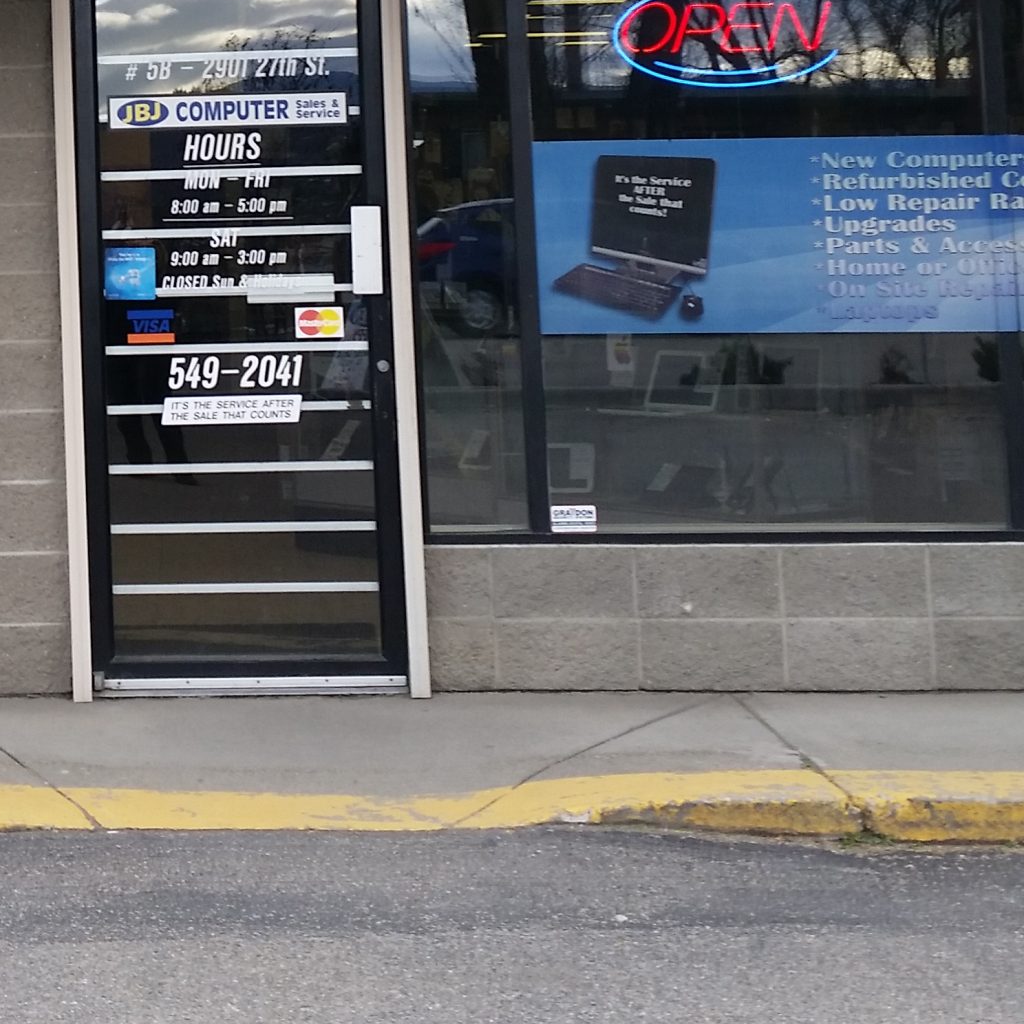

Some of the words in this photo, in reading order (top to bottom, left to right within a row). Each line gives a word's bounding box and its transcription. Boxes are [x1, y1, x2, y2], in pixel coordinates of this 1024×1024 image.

[620, 0, 832, 53] OPEN
[125, 65, 138, 80] #
[146, 61, 172, 80] 5B
[255, 57, 297, 77] 27th
[304, 56, 330, 76] St.
[123, 102, 161, 124] JBJ
[176, 100, 289, 122] COMPUTER
[296, 100, 326, 109] Sales
[332, 99, 339, 108] &
[296, 108, 341, 118] Service
[183, 132, 262, 161] HOURS
[184, 171, 221, 190] MON
[244, 170, 271, 189] FRI
[615, 175, 630, 184] It's
[631, 176, 648, 185] the
[649, 176, 692, 187] Service
[634, 186, 666, 196] AFTER
[170, 200, 199, 215] 8:00
[202, 202, 220, 214] am
[237, 198, 266, 213] 5:00
[268, 200, 288, 215] pm
[619, 194, 634, 203] the
[636, 196, 657, 205] Sale
[660, 198, 683, 209] that
[888, 194, 980, 213] Repair
[990, 193, 1024, 210] Ra
[629, 206, 668, 217] counts!
[210, 228, 240, 248] SAT
[910, 237, 929, 254] &
[170, 251, 199, 267] 9:00
[202, 254, 219, 266] am
[237, 250, 266, 265] 3:00
[268, 252, 288, 266] pm
[917, 262, 947, 276] or
[162, 276, 208, 289] CLOSED
[212, 275, 234, 289] Sun
[238, 274, 249, 288] &
[876, 280, 927, 298] Site
[132, 320, 170, 333] VISA
[168, 355, 303, 389] 549-2041
[172, 402, 189, 410] IT'S
[194, 401, 212, 409] THE
[216, 400, 258, 409] SERVICE
[262, 399, 294, 408] AFTER
[171, 412, 189, 421] THE
[194, 412, 218, 420] SALE
[222, 411, 245, 419] THAT
[250, 410, 291, 419] COUNTS
